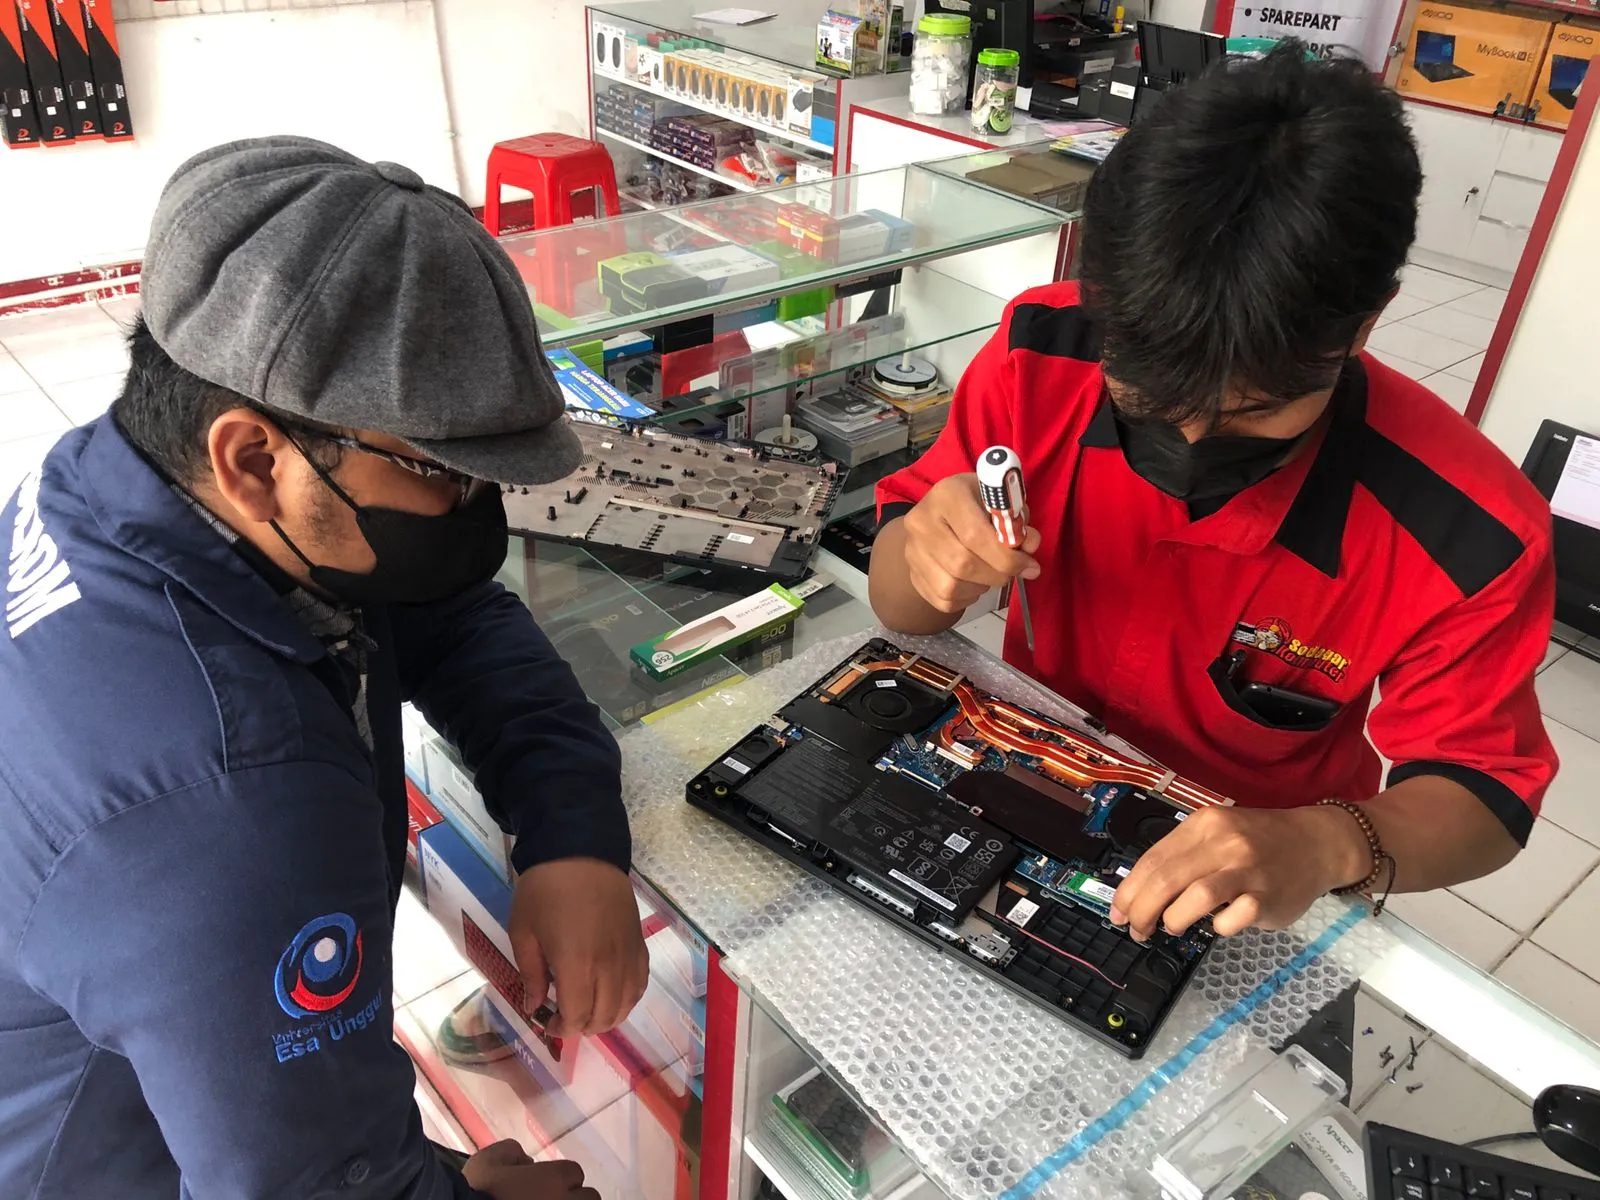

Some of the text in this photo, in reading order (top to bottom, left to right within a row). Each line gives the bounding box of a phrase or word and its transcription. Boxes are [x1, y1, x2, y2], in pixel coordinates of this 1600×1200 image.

[1260, 7, 1341, 31] SPAREPART
[655, 654, 672, 665] 256
[275, 987, 384, 1064] Esa Unggul
[1323, 1123, 1355, 1156] Apacer
